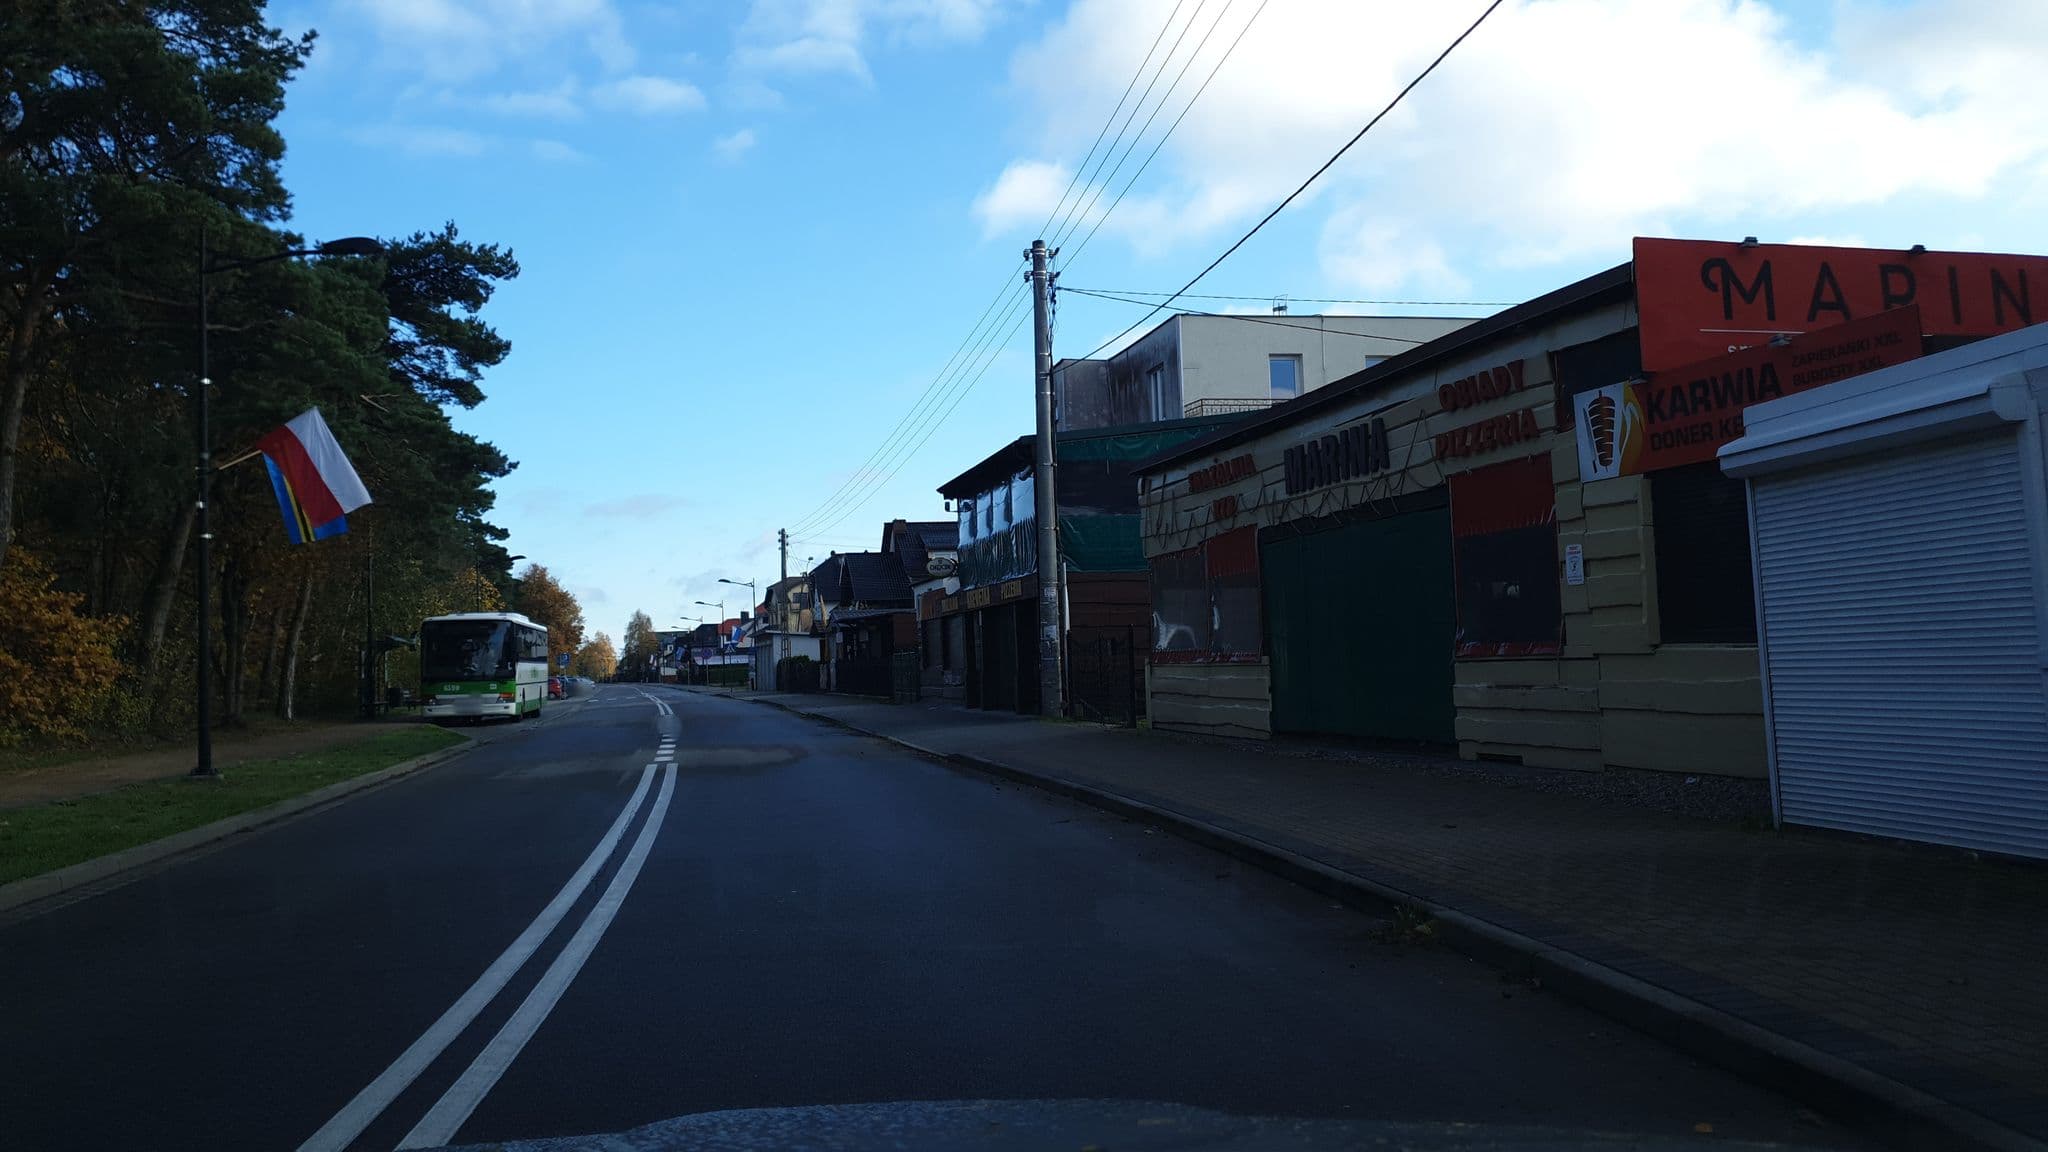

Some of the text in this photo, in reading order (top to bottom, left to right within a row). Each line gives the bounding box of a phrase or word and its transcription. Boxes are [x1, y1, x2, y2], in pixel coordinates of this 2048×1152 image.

[1439, 359, 1524, 412] OBIADY
[1646, 361, 1783, 425] KARWIA
[1283, 417, 1390, 496] MARINA
[1436, 408, 1538, 460] PIZZERIA
